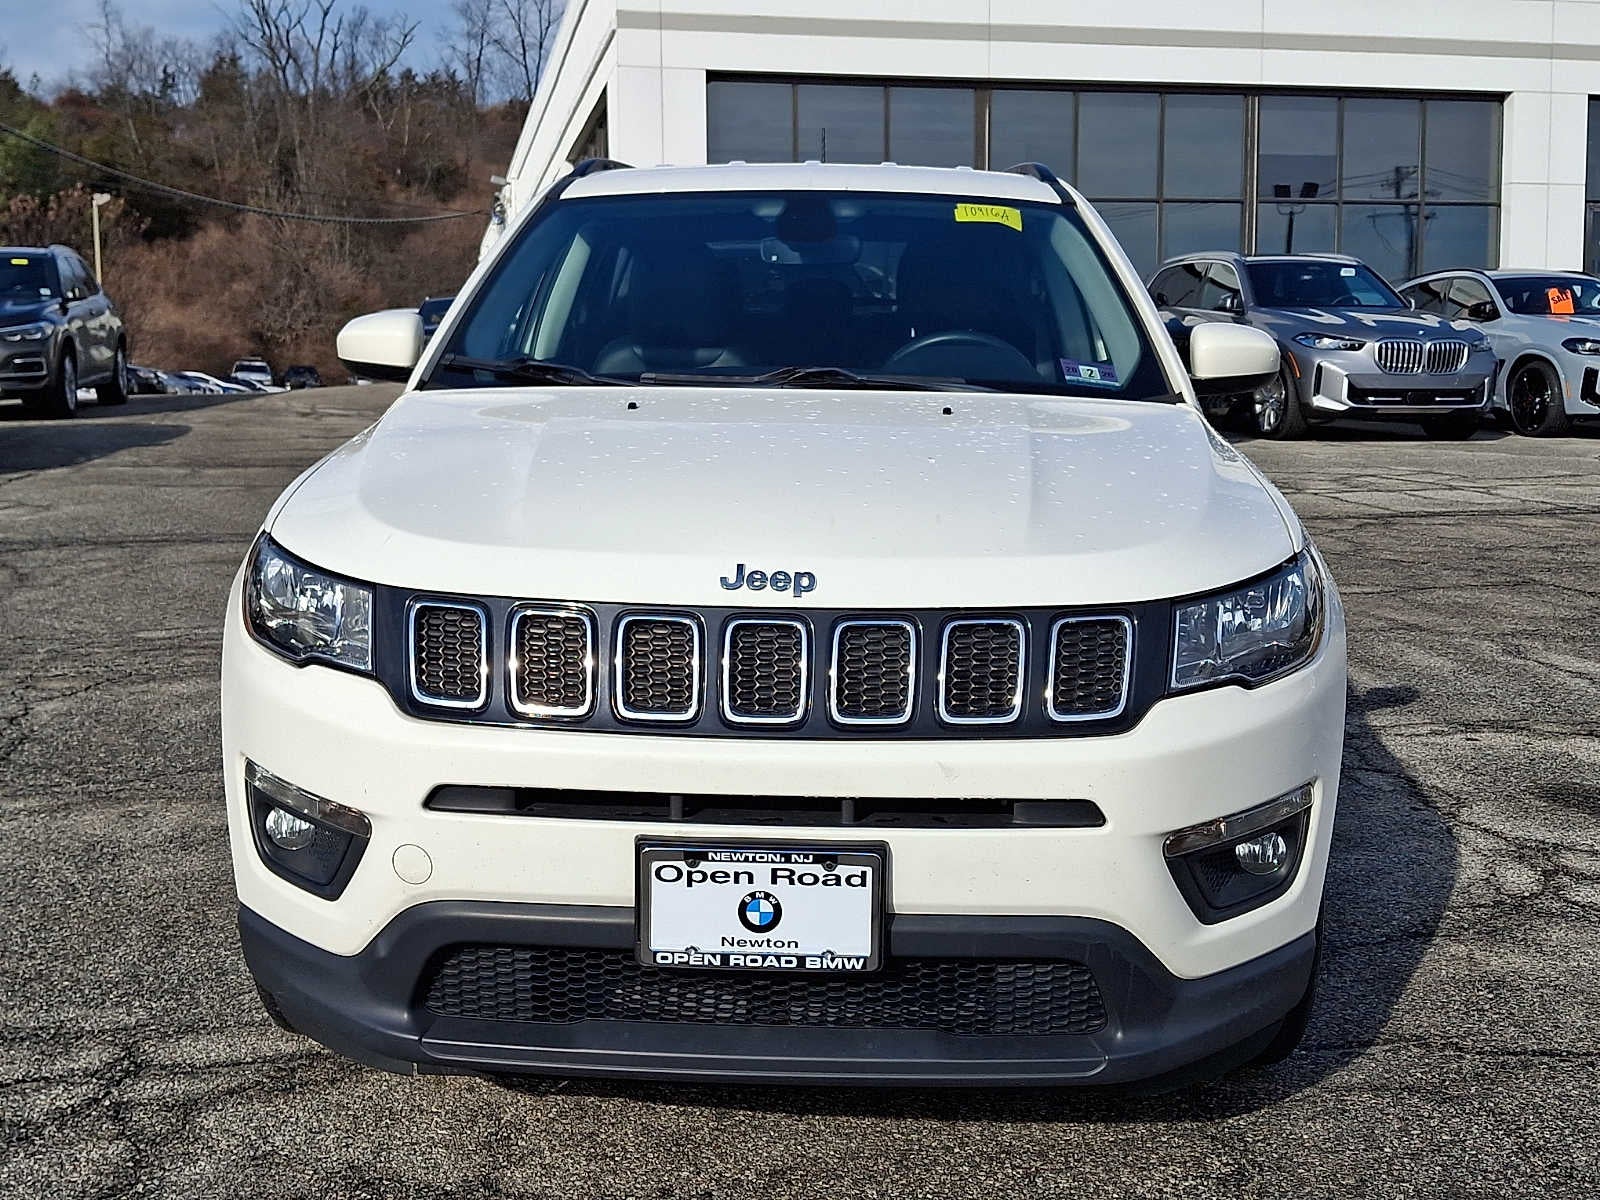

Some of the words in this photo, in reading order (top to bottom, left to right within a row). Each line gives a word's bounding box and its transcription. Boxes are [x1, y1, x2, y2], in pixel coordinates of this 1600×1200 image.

[1086, 368, 1095, 378] 2
[719, 563, 817, 598] Jeep
[791, 853, 813, 863] NJ
[654, 864, 754, 888] Open
[770, 866, 867, 888] Road
[743, 891, 778, 905] BMW
[721, 936, 799, 949] Newton
[655, 951, 721, 966] OPEN
[729, 953, 798, 968] ROAD
[805, 954, 865, 970] BMW
